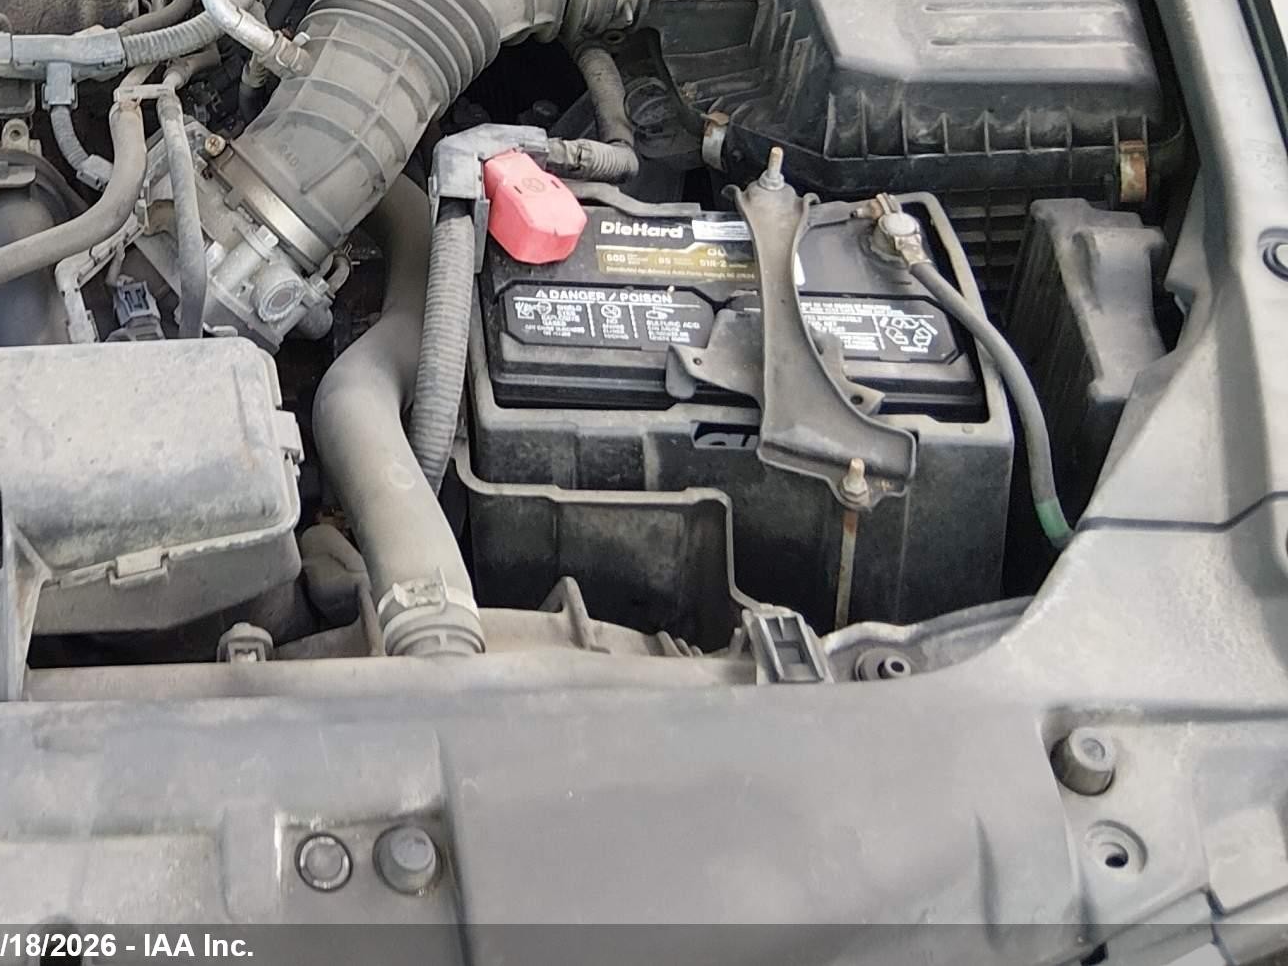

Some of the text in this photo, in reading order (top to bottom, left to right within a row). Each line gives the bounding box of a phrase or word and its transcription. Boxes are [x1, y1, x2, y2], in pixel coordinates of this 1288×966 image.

[600, 220, 684, 239] DieHard
[549, 289, 605, 301] DANGER
[619, 293, 673, 304] POISON
